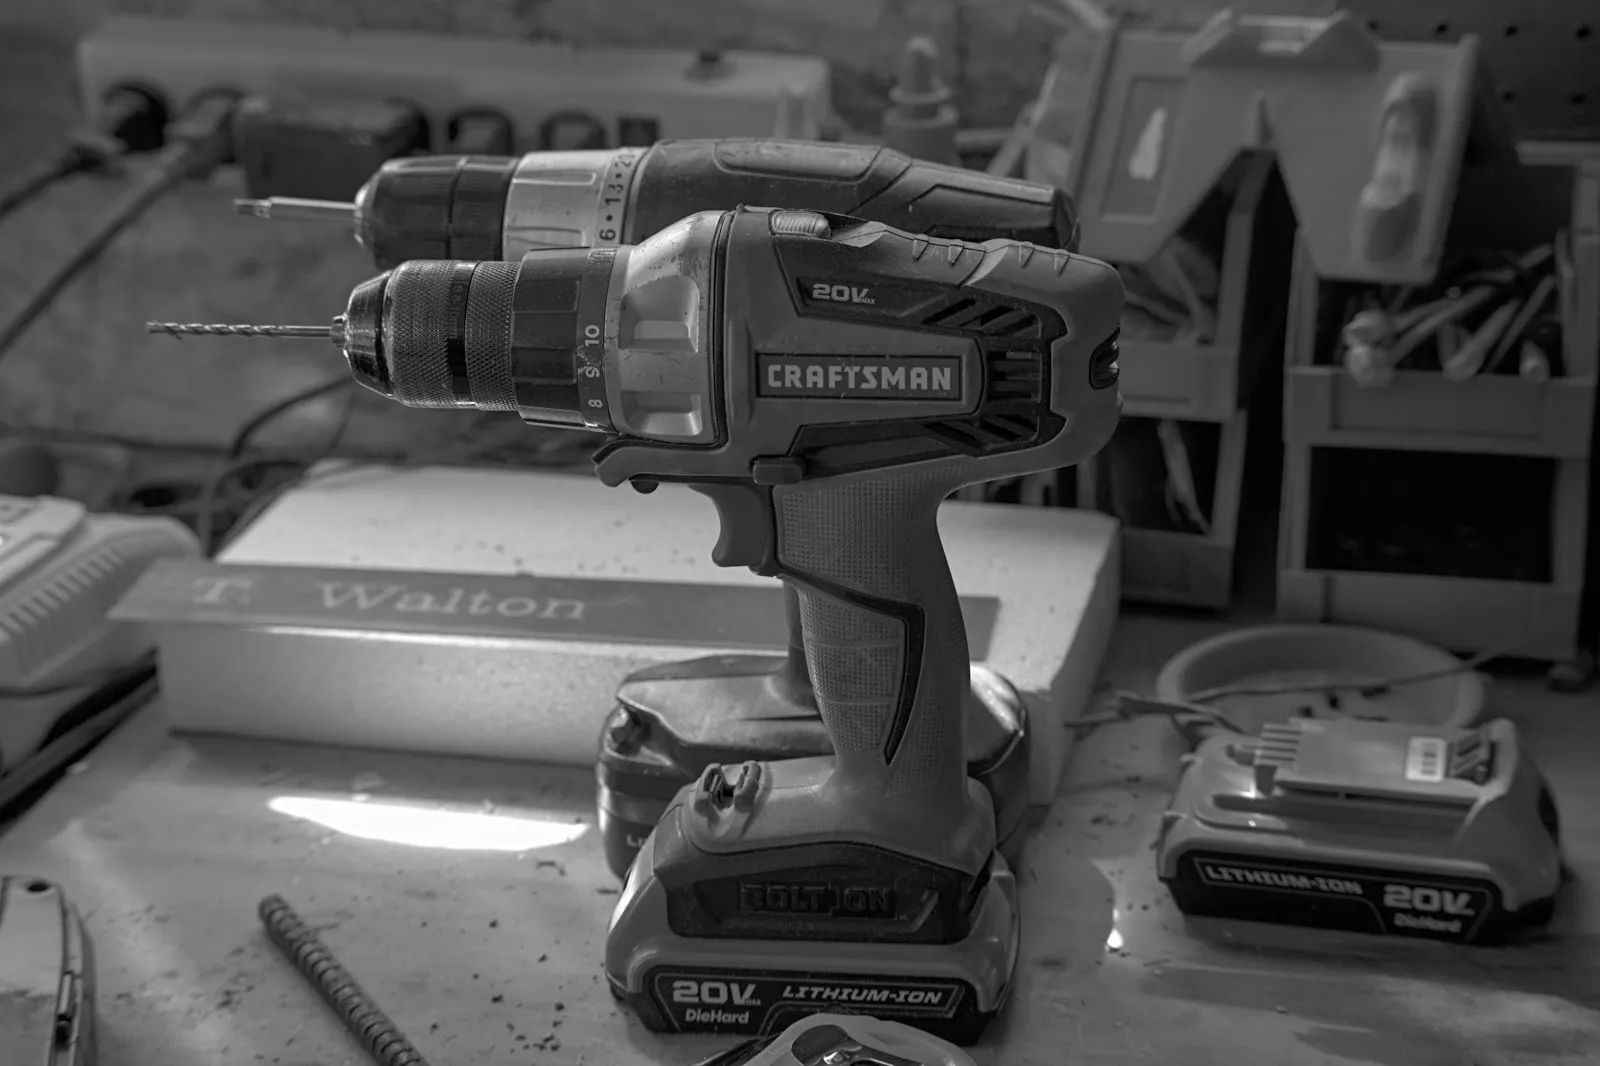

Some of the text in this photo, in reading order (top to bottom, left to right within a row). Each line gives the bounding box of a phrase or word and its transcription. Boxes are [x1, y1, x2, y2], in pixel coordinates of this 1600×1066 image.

[604, 183, 624, 206] 13
[598, 228, 616, 241] 6
[585, 324, 600, 346] 10
[584, 366, 600, 378] 9
[768, 364, 951, 390] CRAFTSMAN
[588, 399, 603, 408] 8
[316, 581, 586, 620] Walton
[1204, 864, 1364, 895] LITHIUM-ION
[740, 883, 827, 912] BOLT
[782, 984, 943, 1005] LITHIUM-ION
[685, 1008, 750, 1024] DieHard
